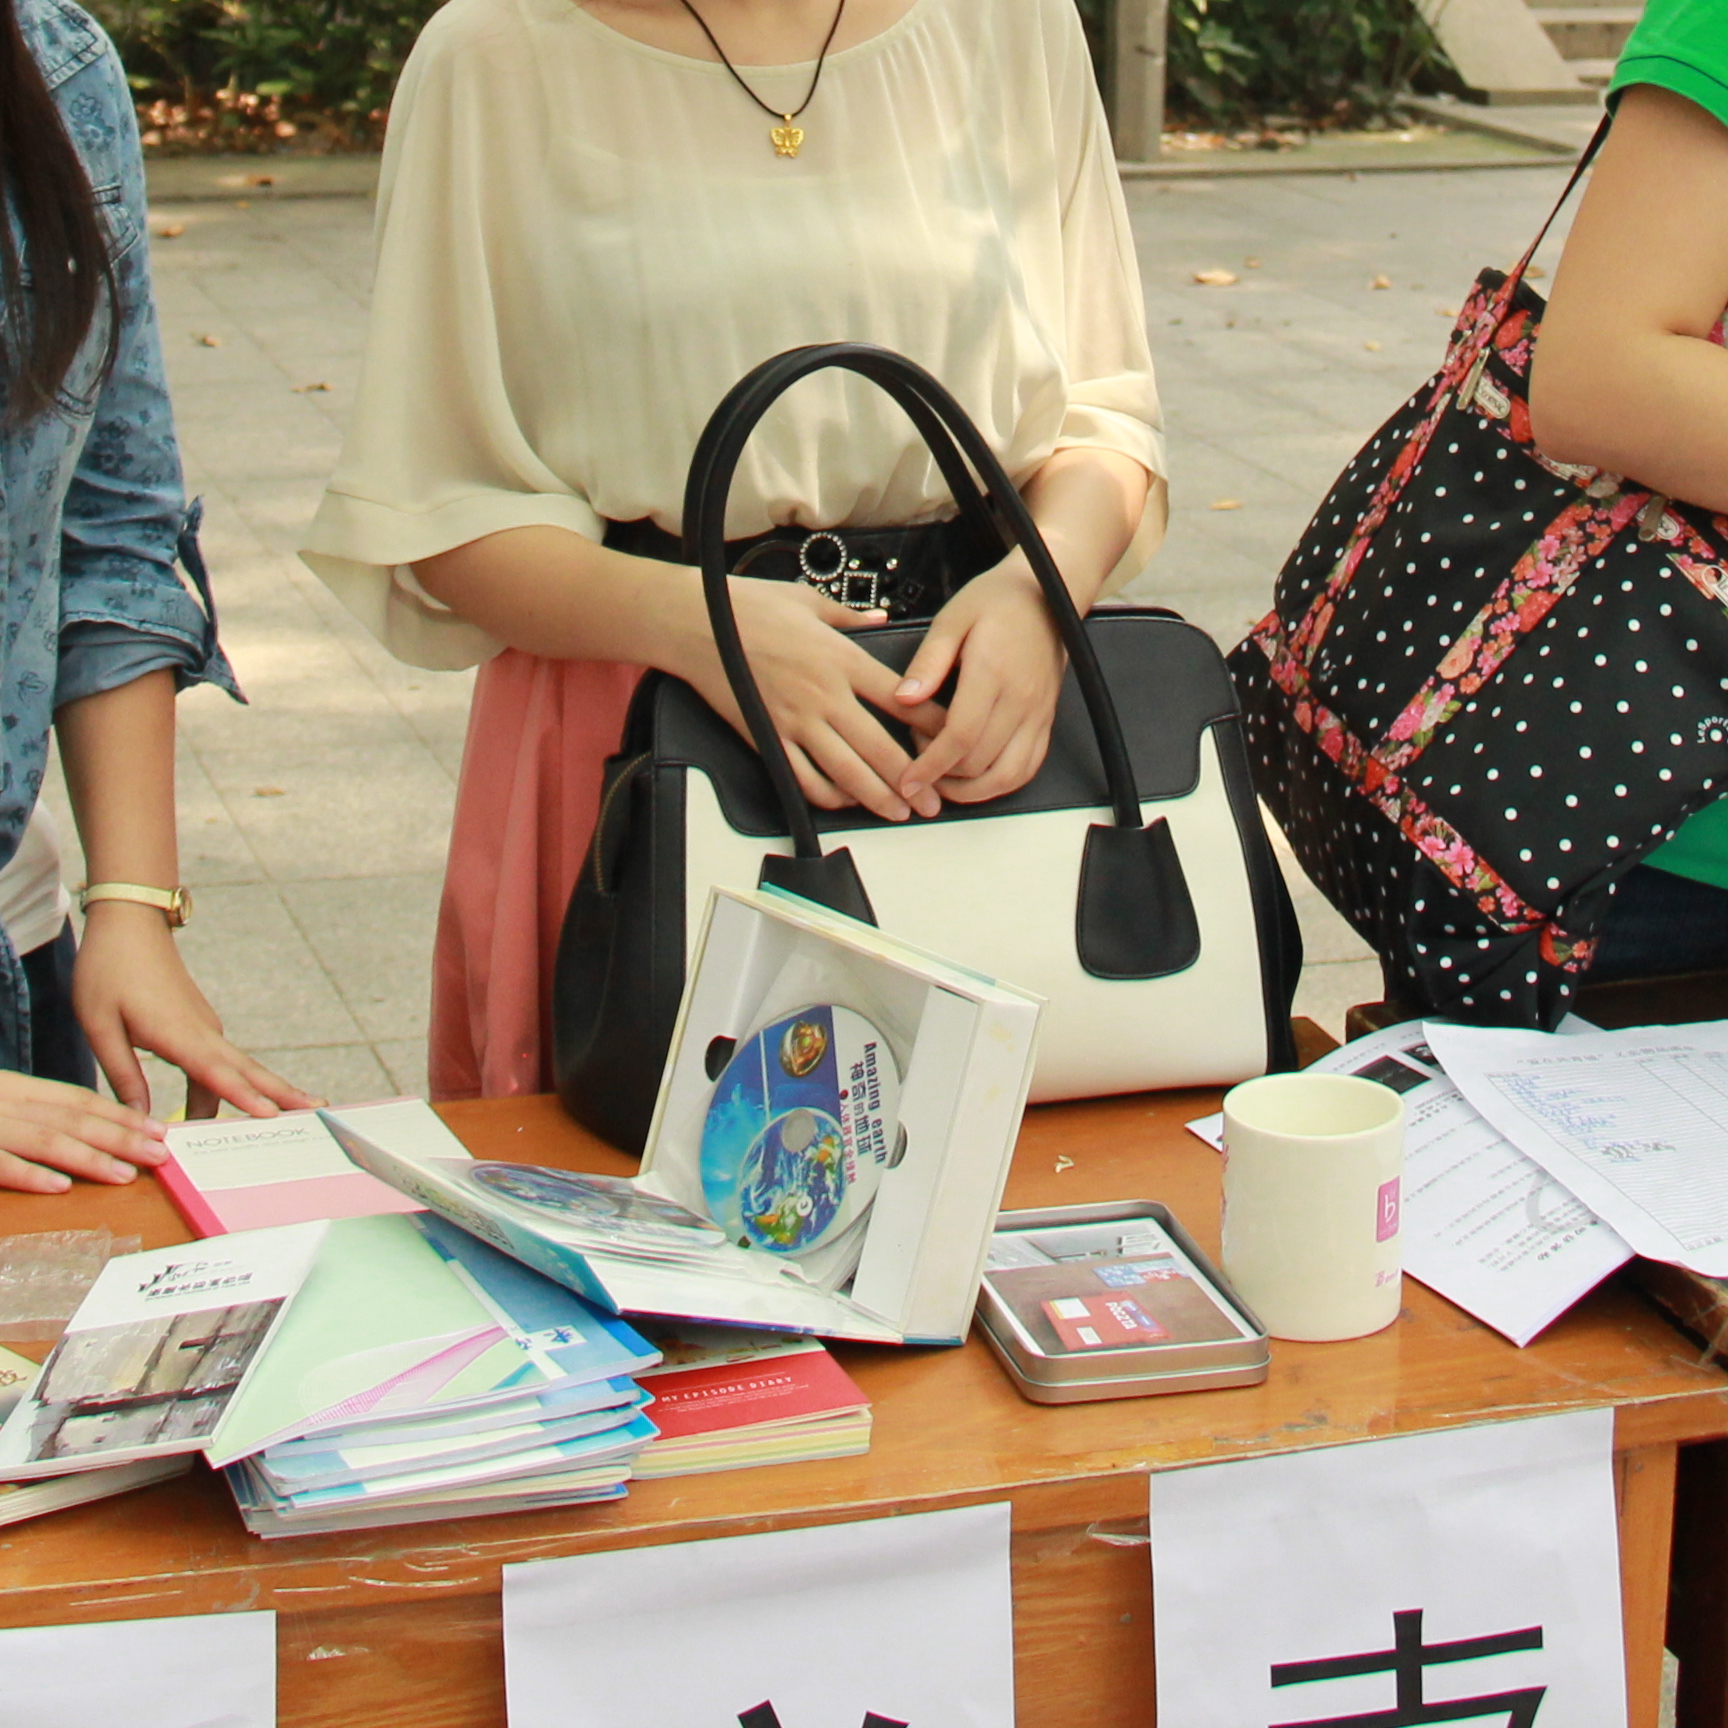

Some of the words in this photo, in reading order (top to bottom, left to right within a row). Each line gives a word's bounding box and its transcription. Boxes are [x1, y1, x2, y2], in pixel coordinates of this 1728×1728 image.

[864, 1041, 881, 1113] Amazing
[186, 1126, 310, 1151] NOTEBOOK
[850, 1060, 873, 1158] 神奇的地球
[872, 1118, 888, 1165] earth
